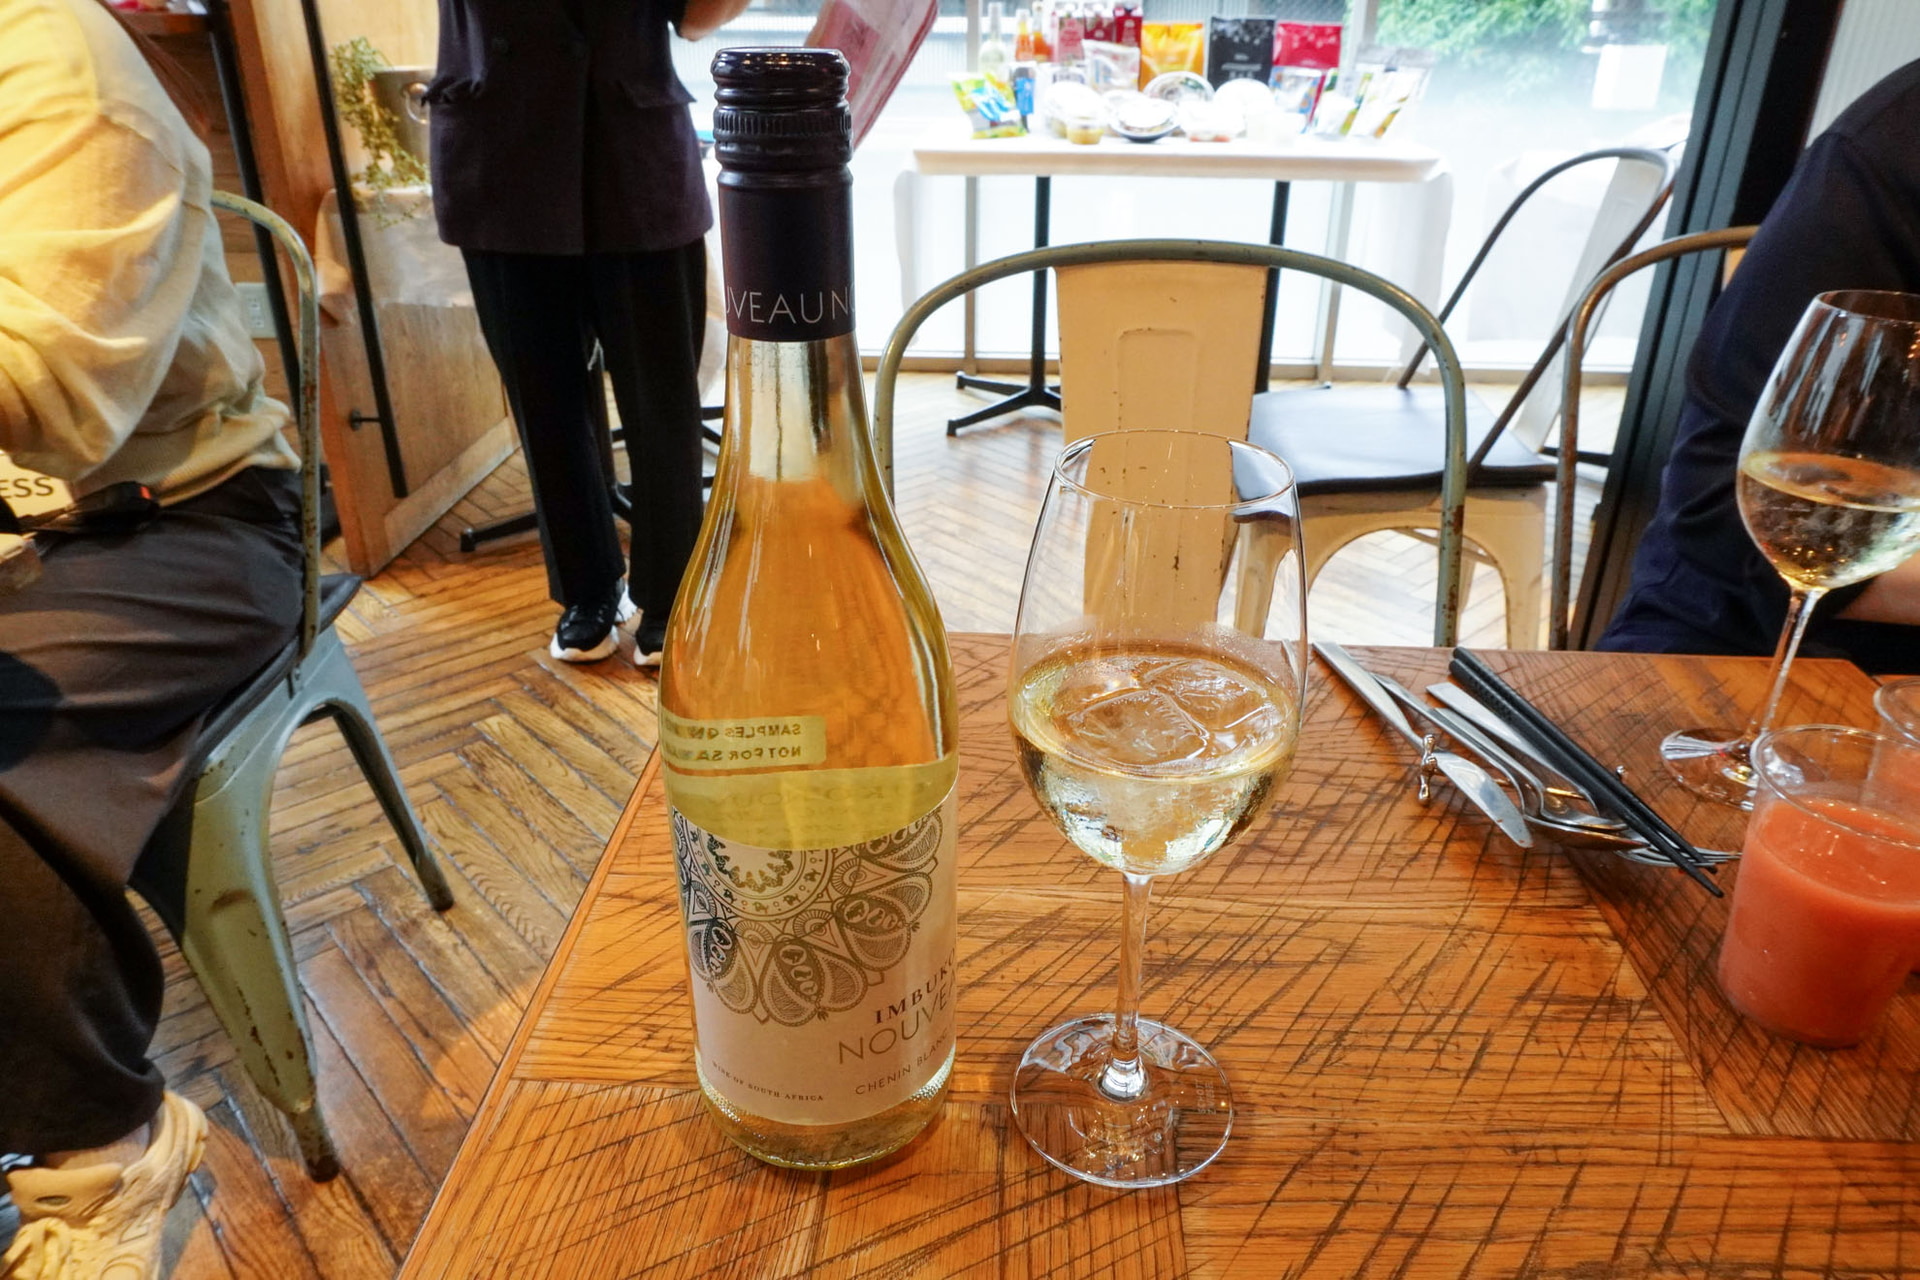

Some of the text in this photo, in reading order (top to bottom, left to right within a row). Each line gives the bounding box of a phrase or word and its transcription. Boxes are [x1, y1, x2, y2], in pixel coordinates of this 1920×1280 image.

[855, 1064, 911, 1095] CHENIN
[748, 1083, 780, 1098] SOUTH
[785, 1093, 823, 1101] AFRICA
